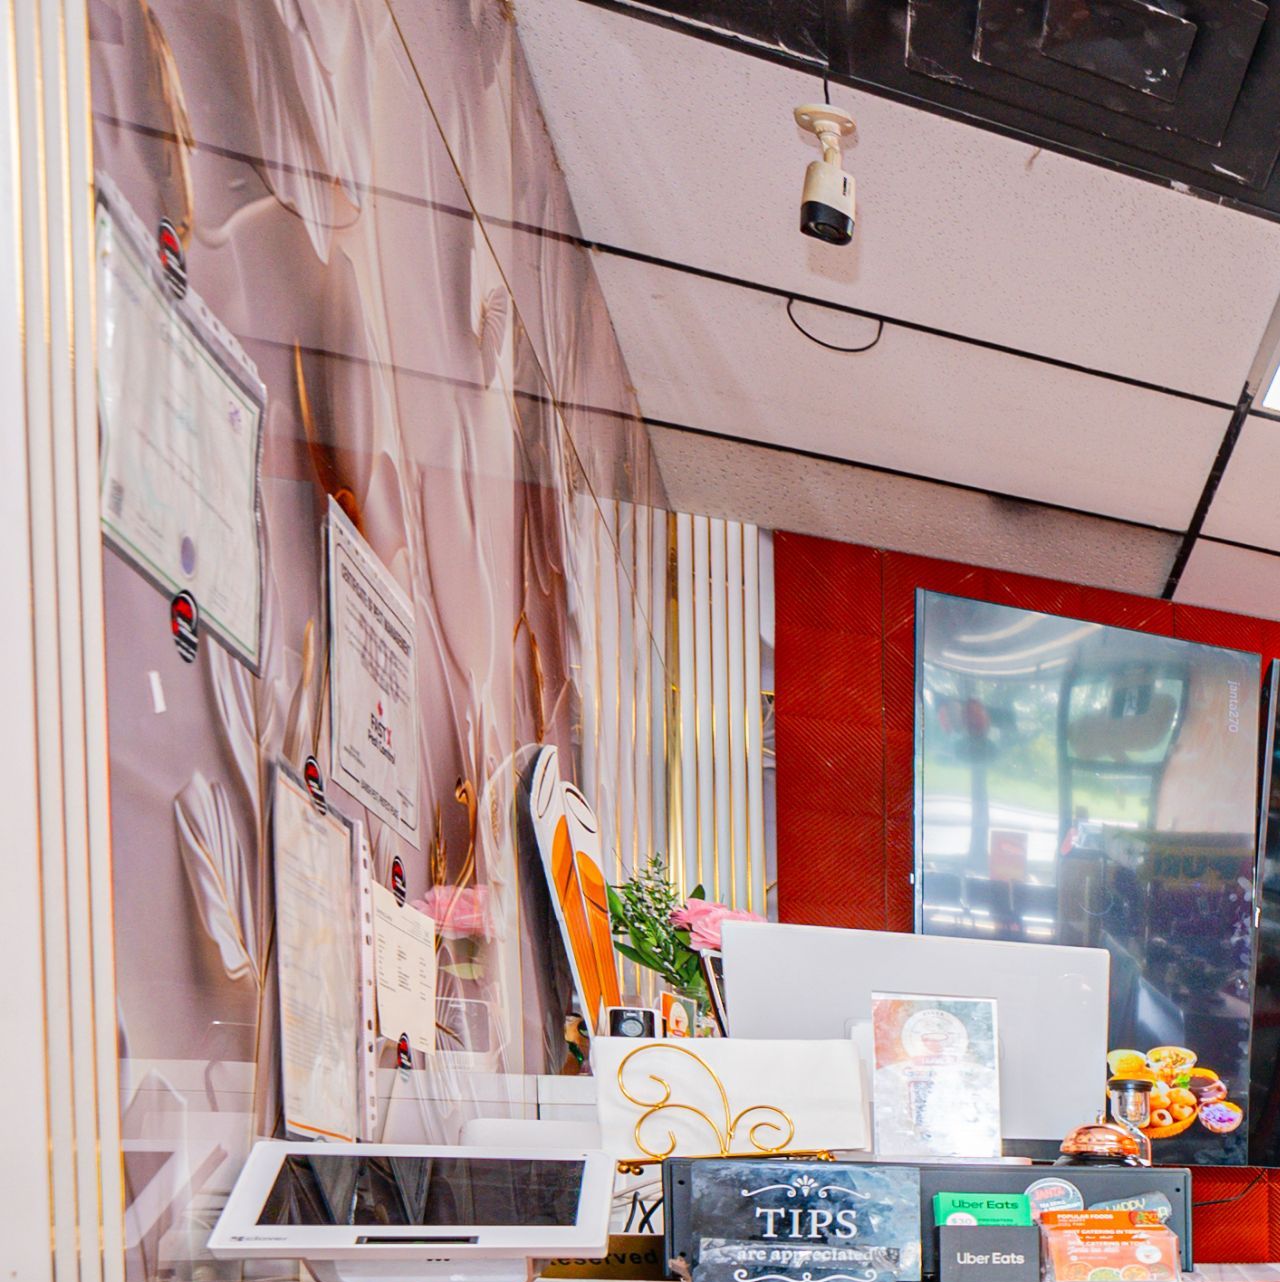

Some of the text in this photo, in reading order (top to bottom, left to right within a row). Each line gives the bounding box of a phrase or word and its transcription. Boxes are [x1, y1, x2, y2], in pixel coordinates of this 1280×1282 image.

[952, 1199, 1019, 1210] Uber Eats
[756, 1206, 857, 1239] TIPS
[550, 1248, 658, 1266] eserved
[736, 1248, 874, 1268] are appreciated
[956, 1251, 1025, 1265] Uber Eats
